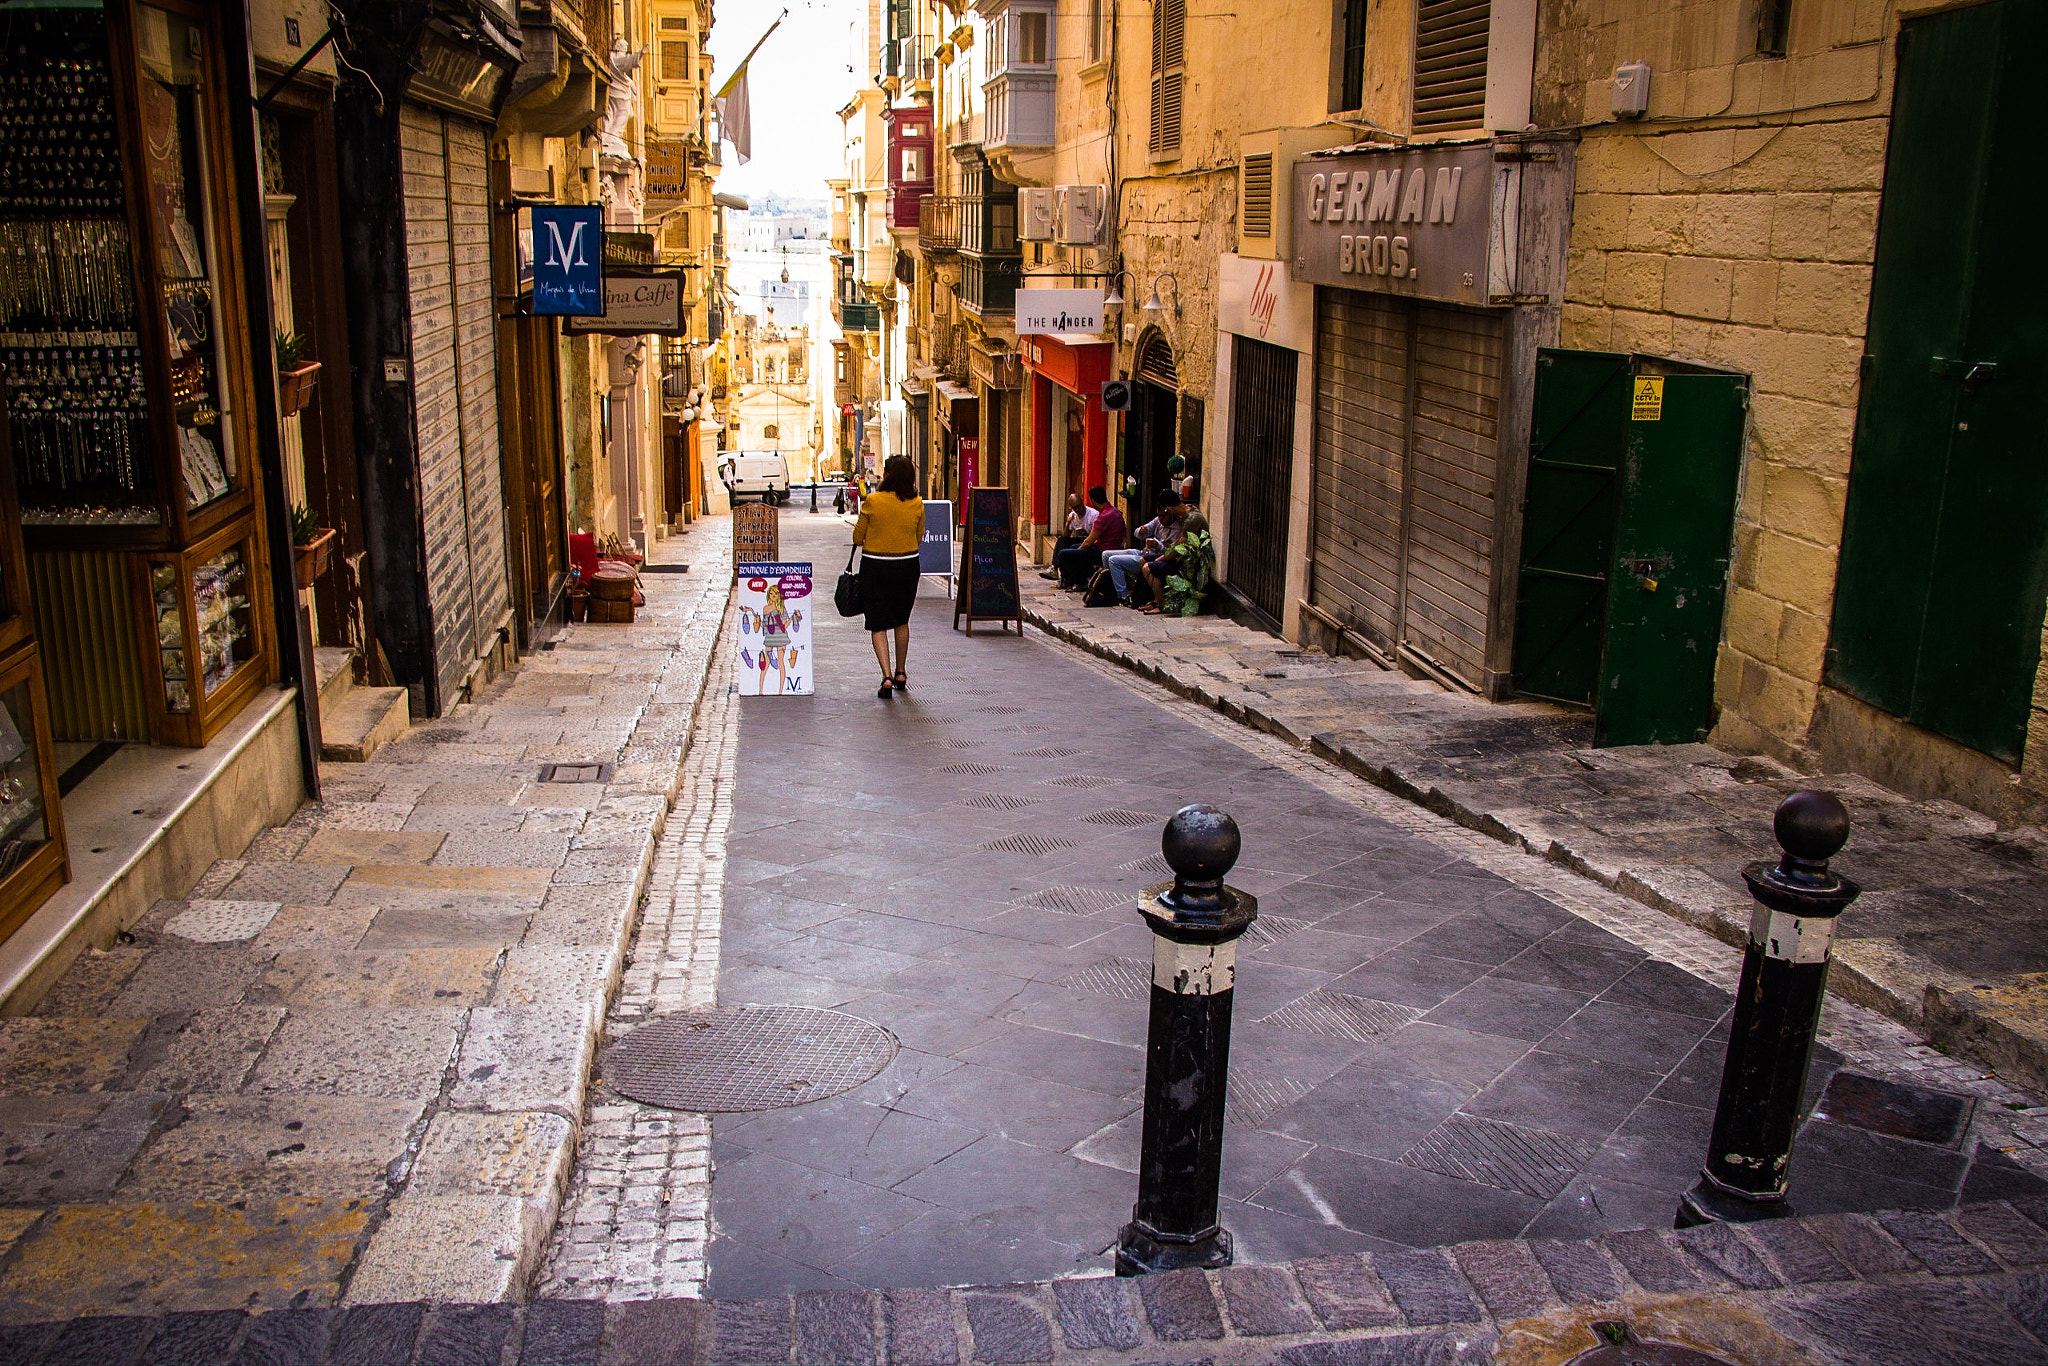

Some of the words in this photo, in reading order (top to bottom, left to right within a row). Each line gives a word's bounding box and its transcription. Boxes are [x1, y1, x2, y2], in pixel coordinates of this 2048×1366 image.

[647, 183, 678, 194] CHURCH
[1307, 166, 1463, 225] GERMAN
[543, 221, 589, 276] M
[1340, 234, 1417, 280] BROS.
[1463, 272, 1473, 286] 26
[1027, 317, 1046, 328] THE
[1052, 311, 1094, 331] HANGER
[1635, 394, 1653, 402] CCTV
[962, 440, 978, 450] NEW
[736, 534, 774, 544] CHURCH
[737, 551, 773, 562] WELCOME
[738, 566, 769, 576] BOUTIQUE
[770, 565, 812, 576] D'ESPADRILLES
[786, 676, 803, 692] M
